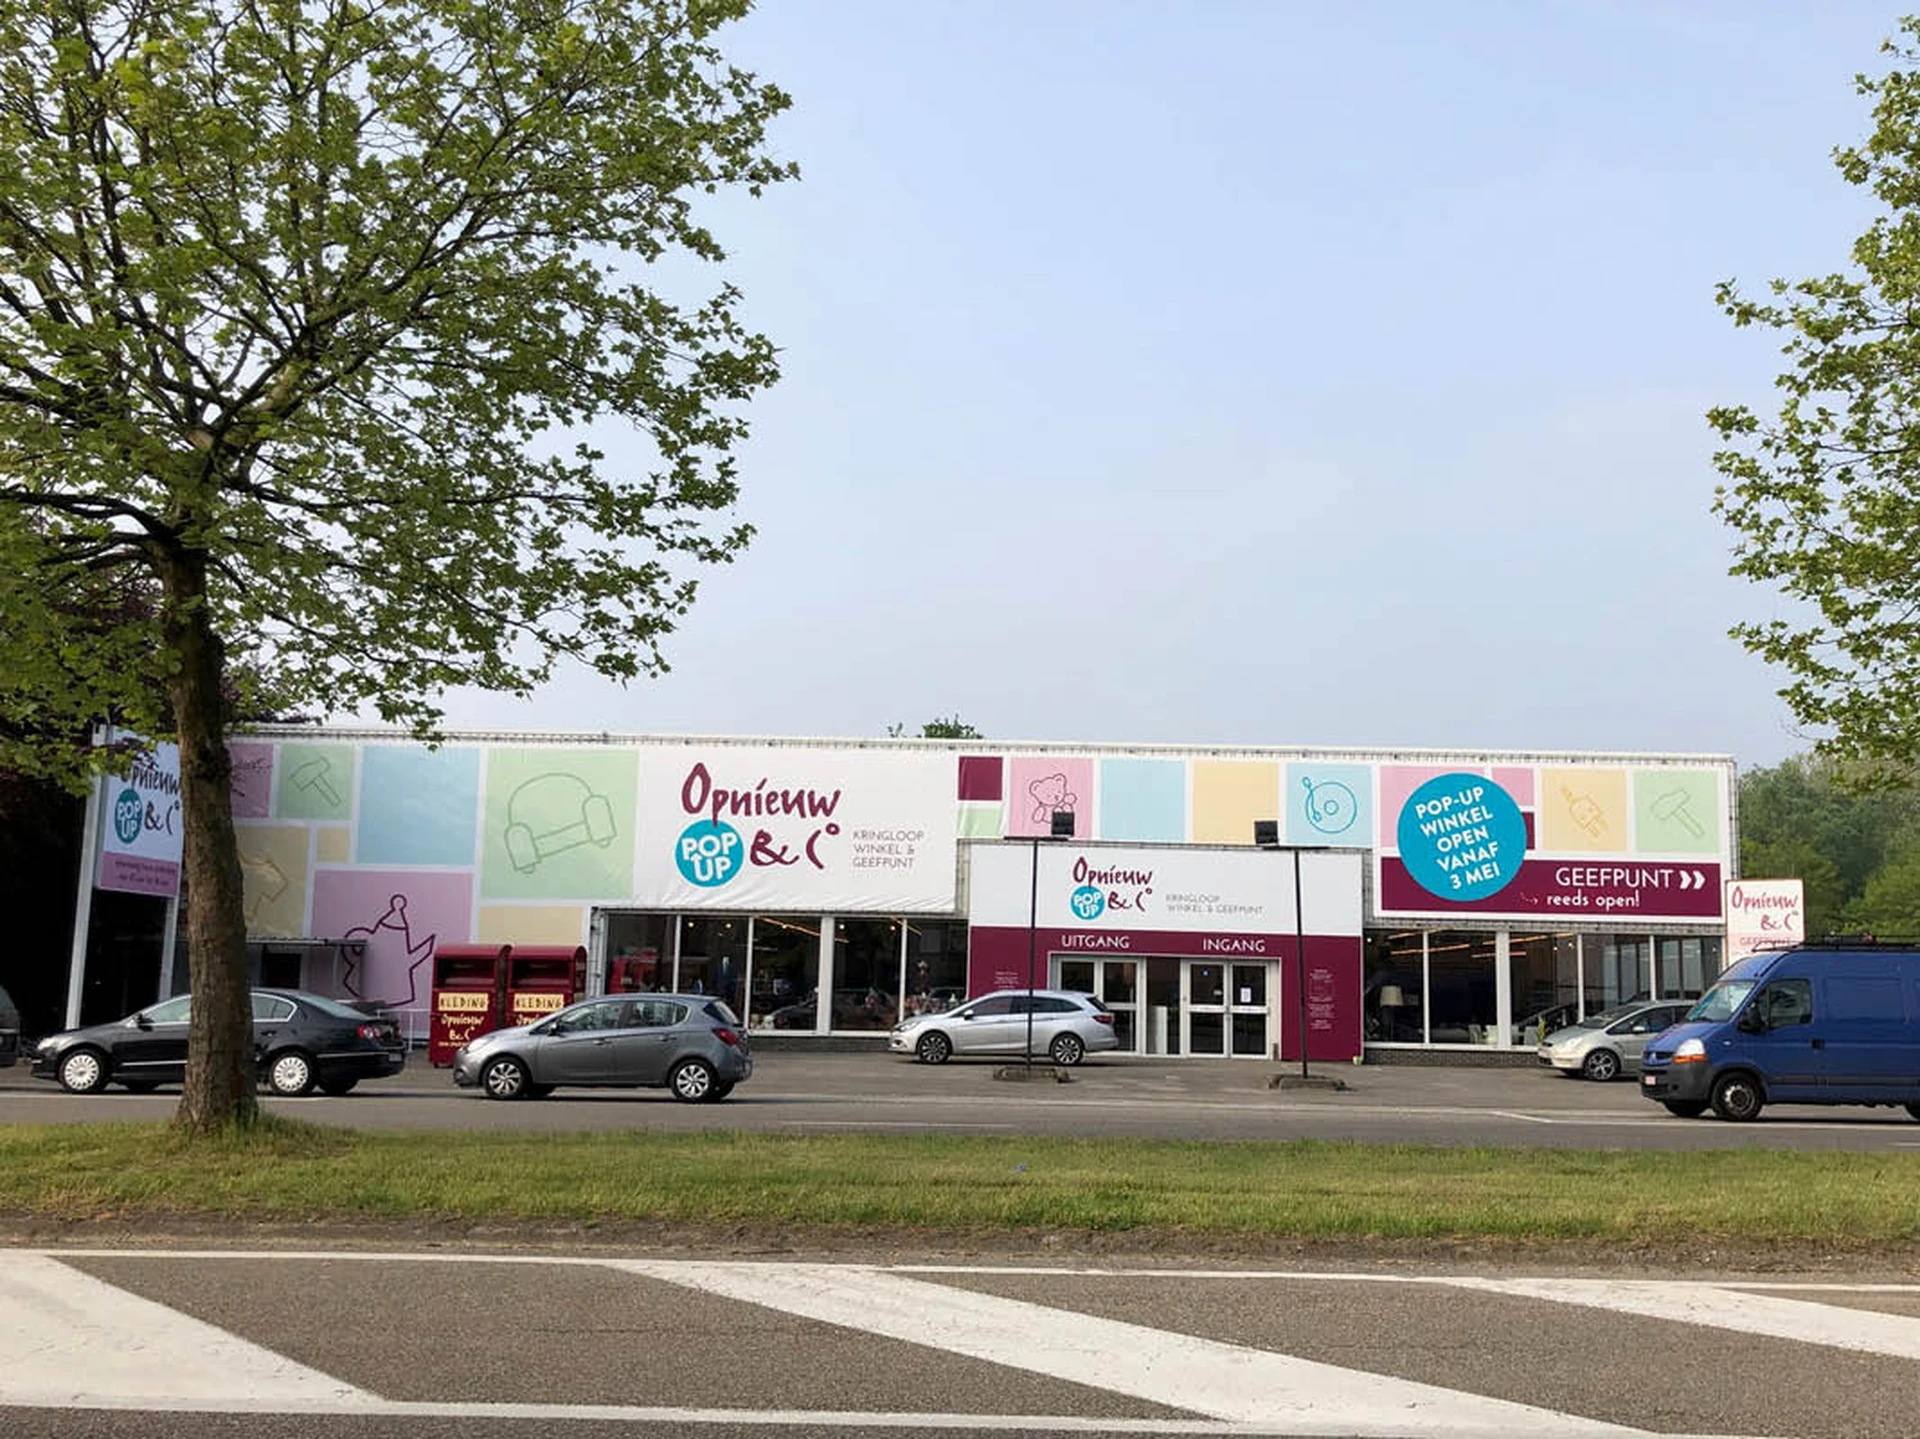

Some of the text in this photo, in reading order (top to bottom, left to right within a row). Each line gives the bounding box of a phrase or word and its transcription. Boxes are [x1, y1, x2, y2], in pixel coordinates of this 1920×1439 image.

[681, 762, 842, 828] Opnieuw
[1415, 786, 1484, 819] POP-UP
[117, 801, 141, 819] POP
[144, 801, 164, 830] &
[119, 818, 138, 839] UP
[1420, 805, 1494, 838] WINKEL
[681, 832, 739, 861] POP
[852, 830, 925, 842] KRINGLOOP
[1436, 825, 1490, 853] OPEN
[750, 829, 800, 866] &
[853, 843, 916, 856] WINKEL &
[1436, 841, 1499, 872] VANAF
[691, 854, 732, 882] UP
[852, 856, 915, 869] GEEFPUNT
[1073, 856, 1153, 888] Opnieuw
[1449, 861, 1501, 890] 3 MEI
[1555, 867, 1674, 889] GEEFPUNT
[1074, 892, 1100, 906] POP
[1107, 891, 1132, 910] &
[1167, 904, 1206, 914] WINKEL
[1547, 889, 1640, 912] reeds open!
[1731, 885, 1799, 915] Opnieuw
[1078, 903, 1099, 917] UP
[1760, 914, 1783, 931] &
[1061, 934, 1131, 949] UITGANG
[1202, 938, 1266, 953] INGANG
[439, 995, 487, 1009] KLEDING
[515, 996, 563, 1009] KLEDING
